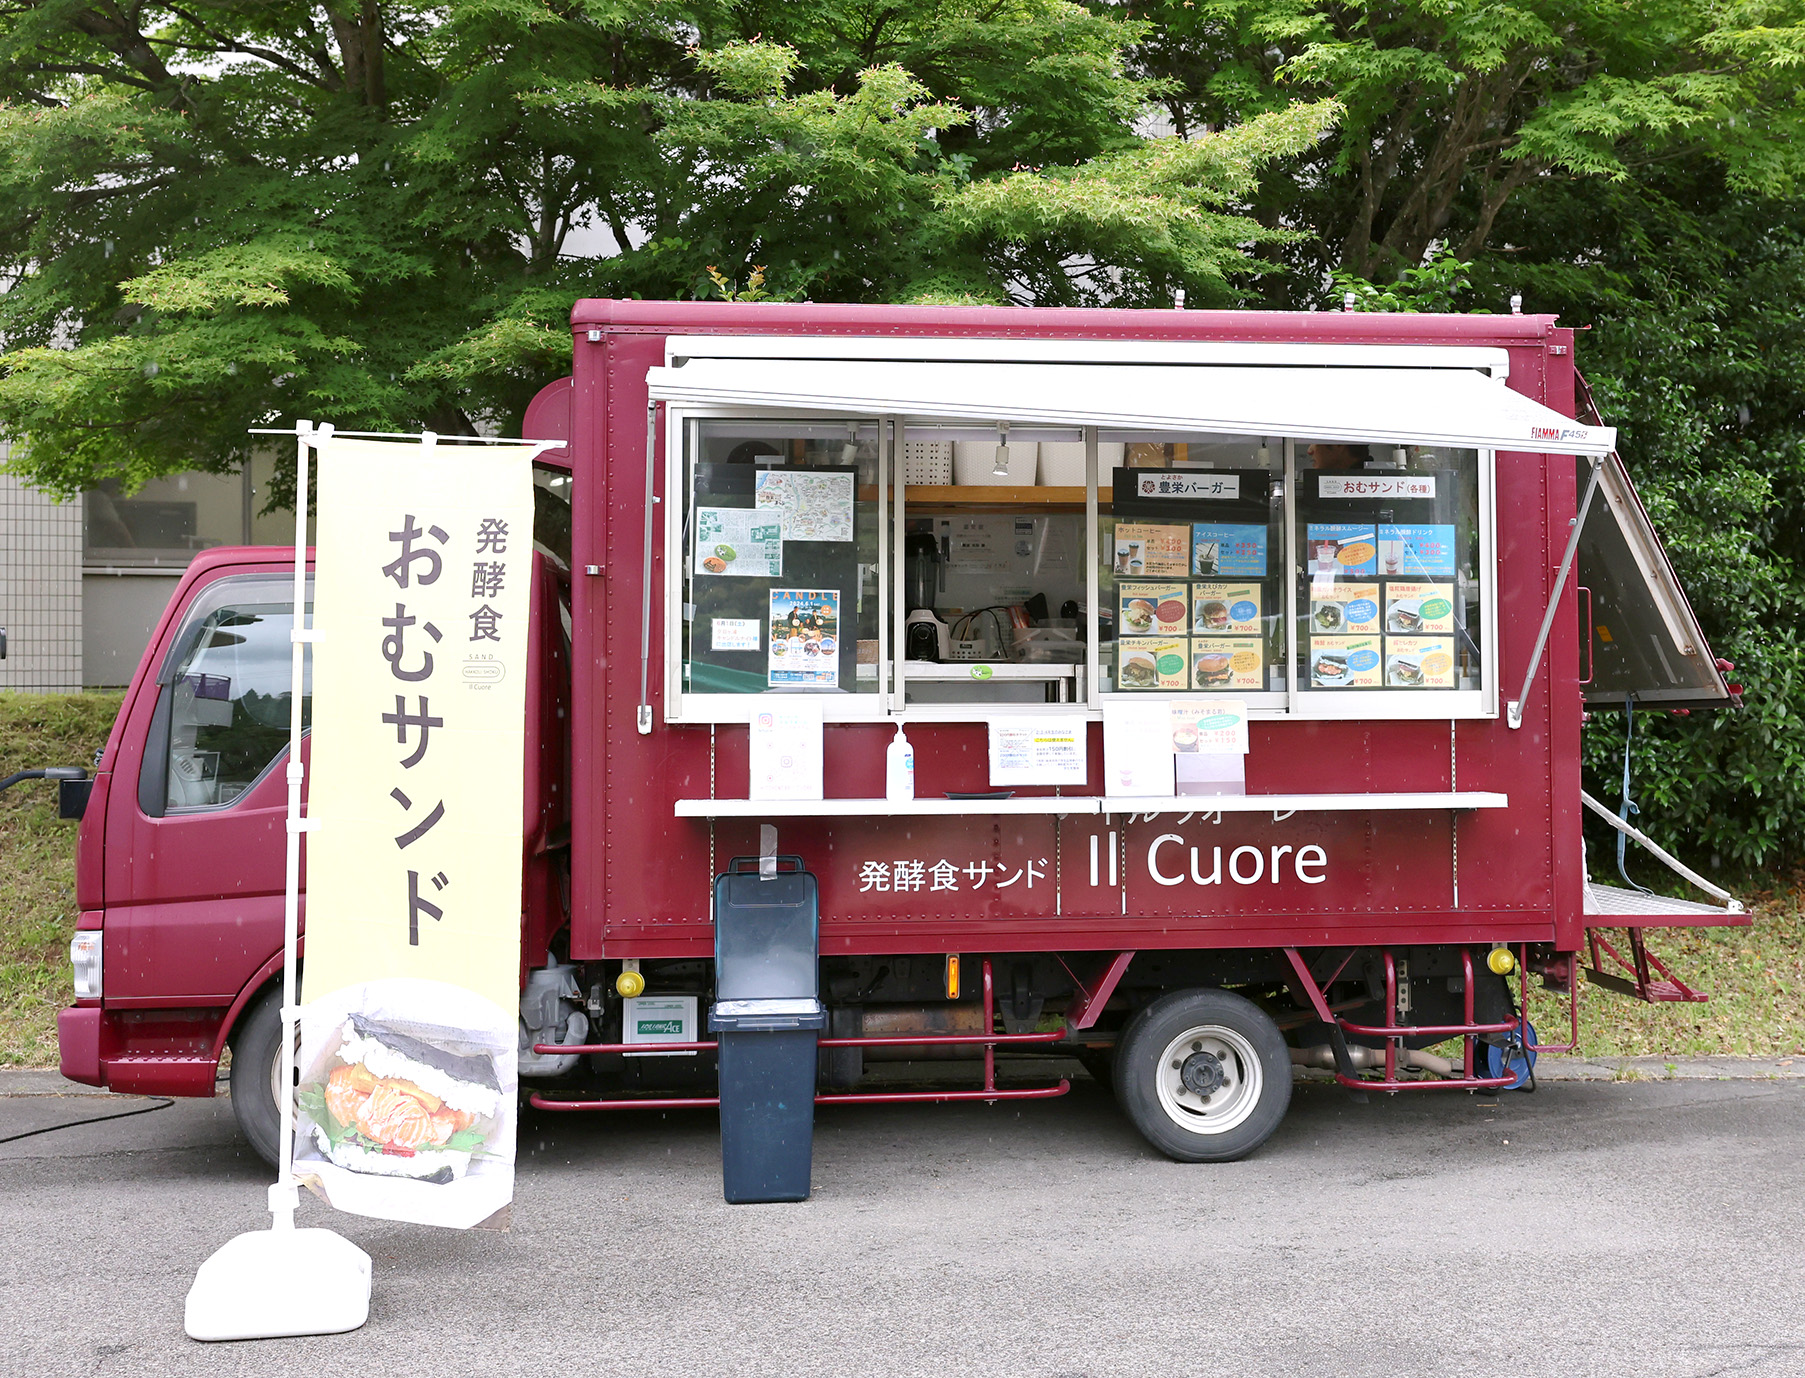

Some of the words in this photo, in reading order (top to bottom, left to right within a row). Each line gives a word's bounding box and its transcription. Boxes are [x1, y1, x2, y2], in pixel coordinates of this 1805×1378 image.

[1531, 427, 1560, 440] FIAMMA
[1159, 481, 1236, 494] 豊栄バーガー
[469, 518, 509, 642] 発酵食
[772, 591, 838, 601] CANDLE
[382, 514, 450, 946] おむサンド
[858, 857, 1048, 892] 発酵食サンド
[1089, 831, 1117, 887] Il
[1147, 834, 1328, 886] Cuore
